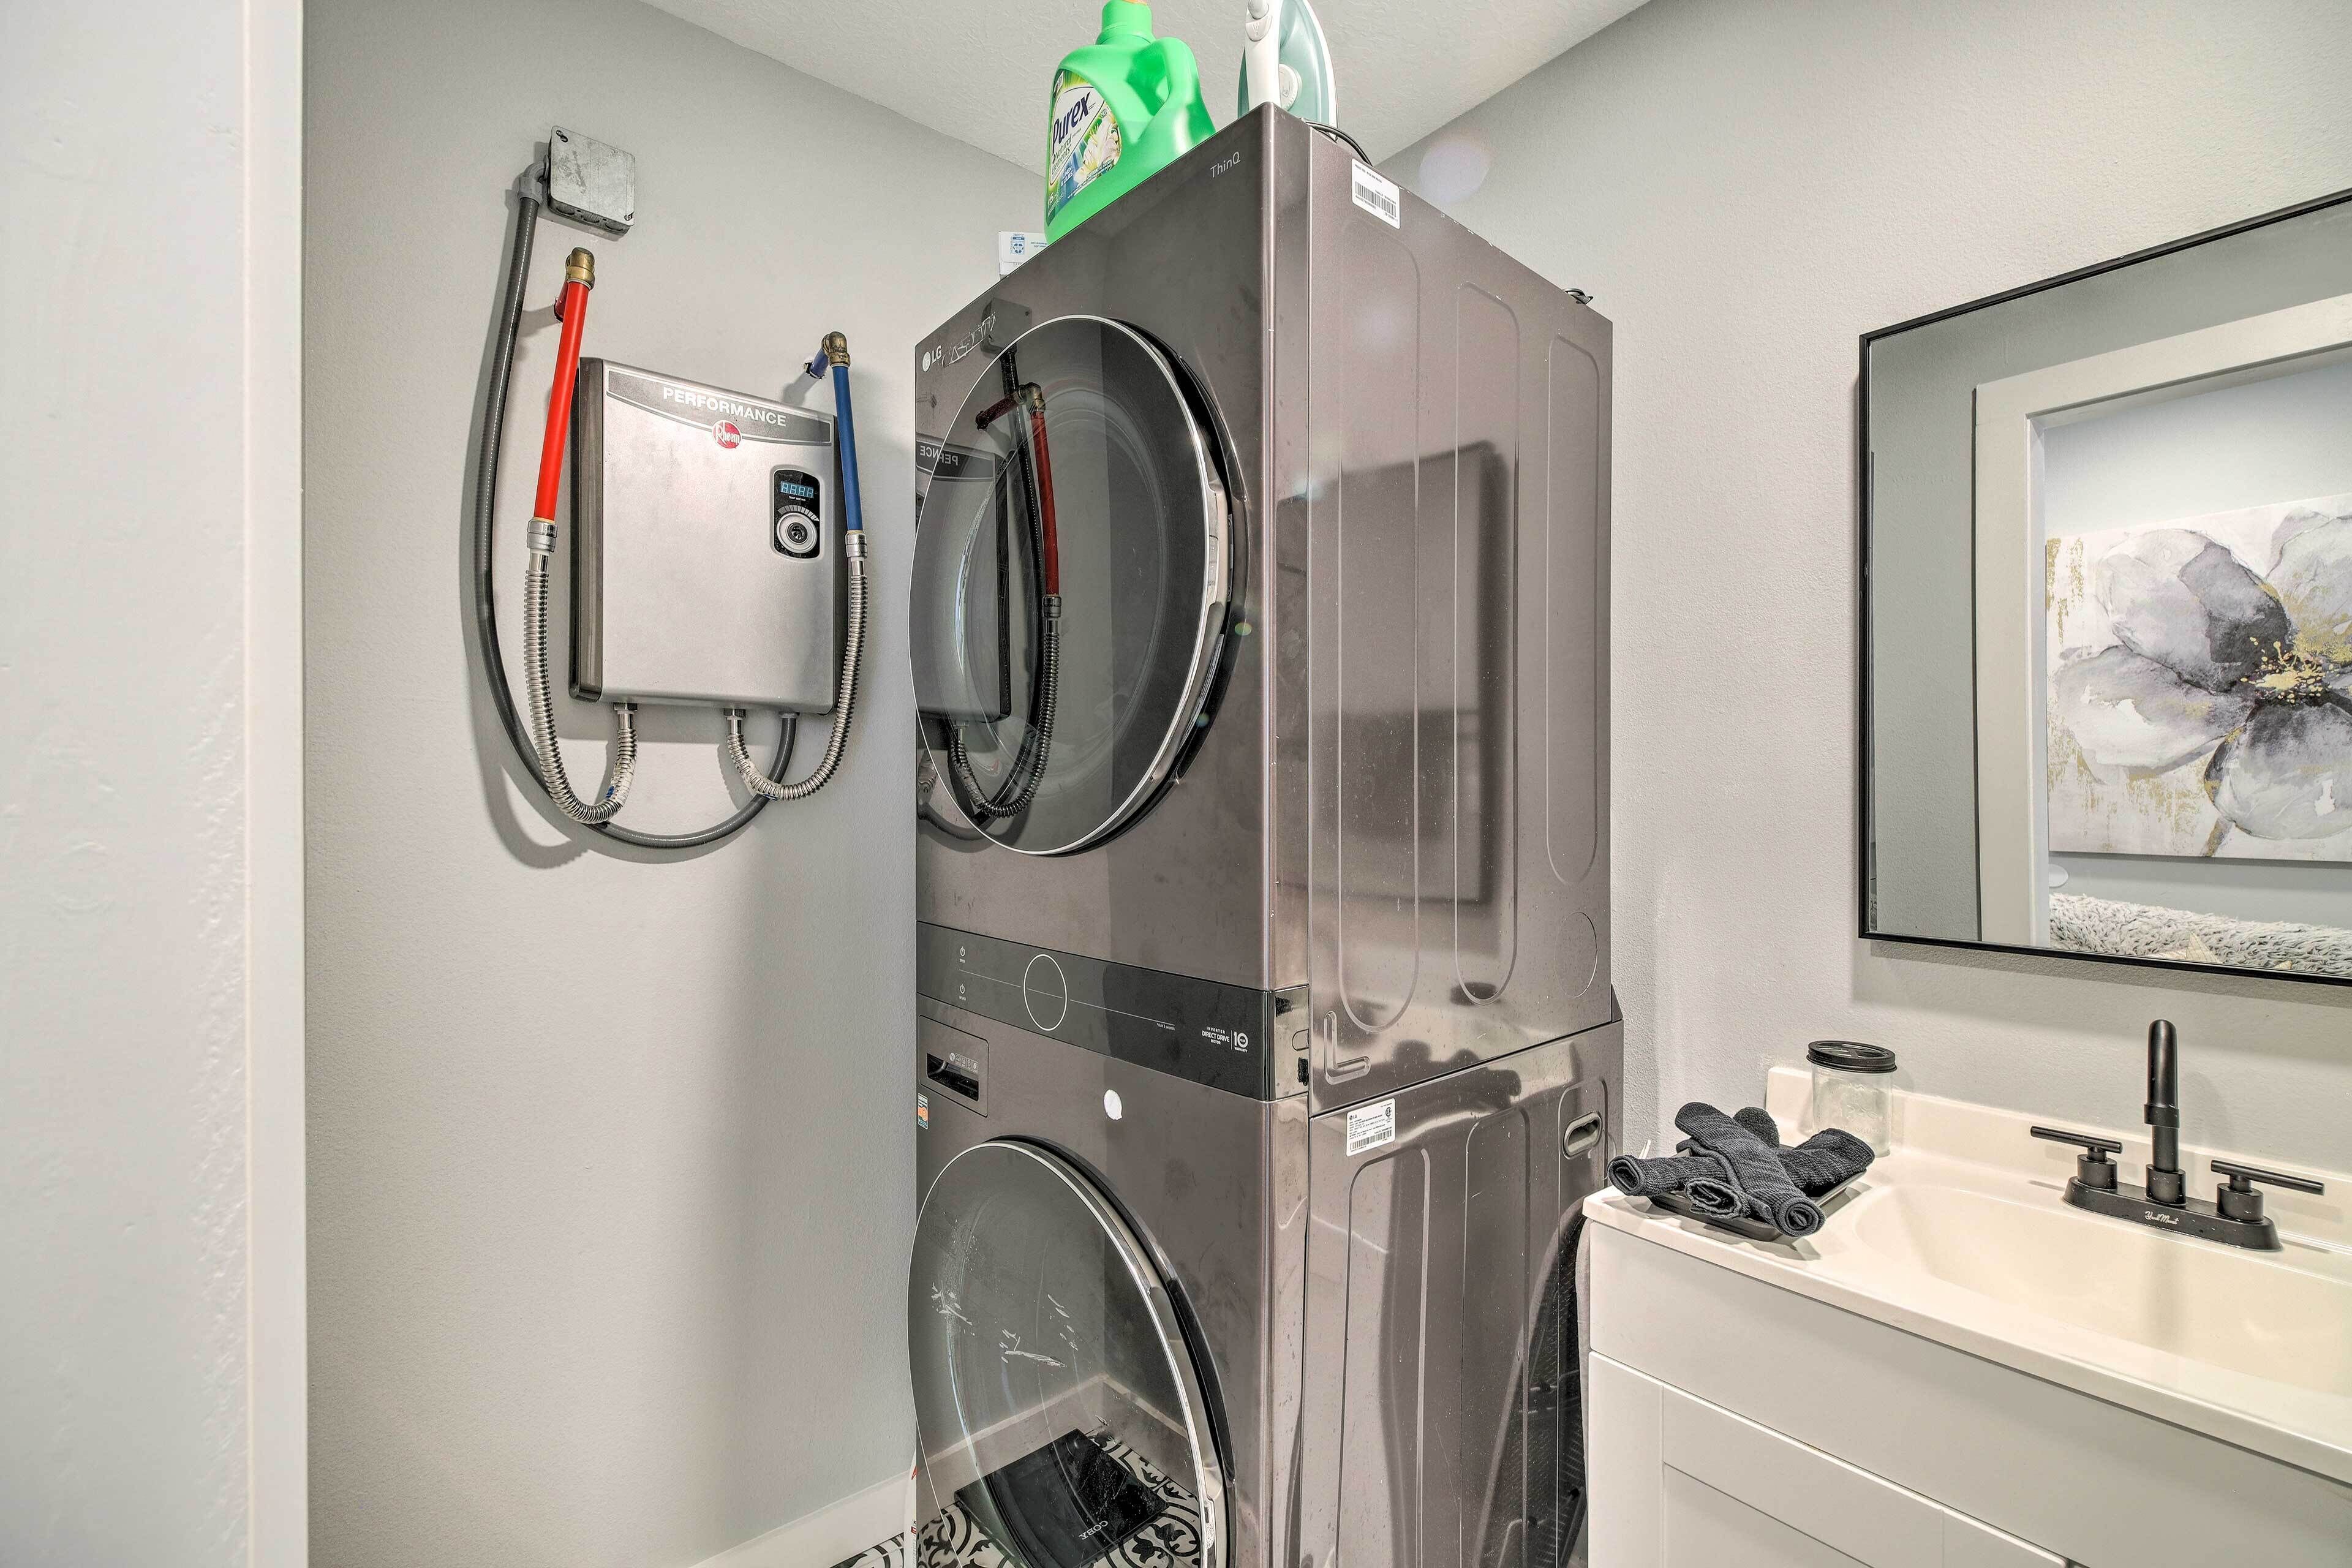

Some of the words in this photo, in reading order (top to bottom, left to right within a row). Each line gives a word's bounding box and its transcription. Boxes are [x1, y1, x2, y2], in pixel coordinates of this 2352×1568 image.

[1052, 91, 1091, 154] Purex
[1210, 151, 1241, 178] ThinQ
[932, 345, 943, 364] LG
[663, 386, 787, 427] PERFORMANCE
[715, 420, 741, 446] Rheem
[1202, 1030, 1216, 1039] DIRECT
[1216, 1034, 1230, 1042] DRIVE
[1234, 1031, 1248, 1048] 10
